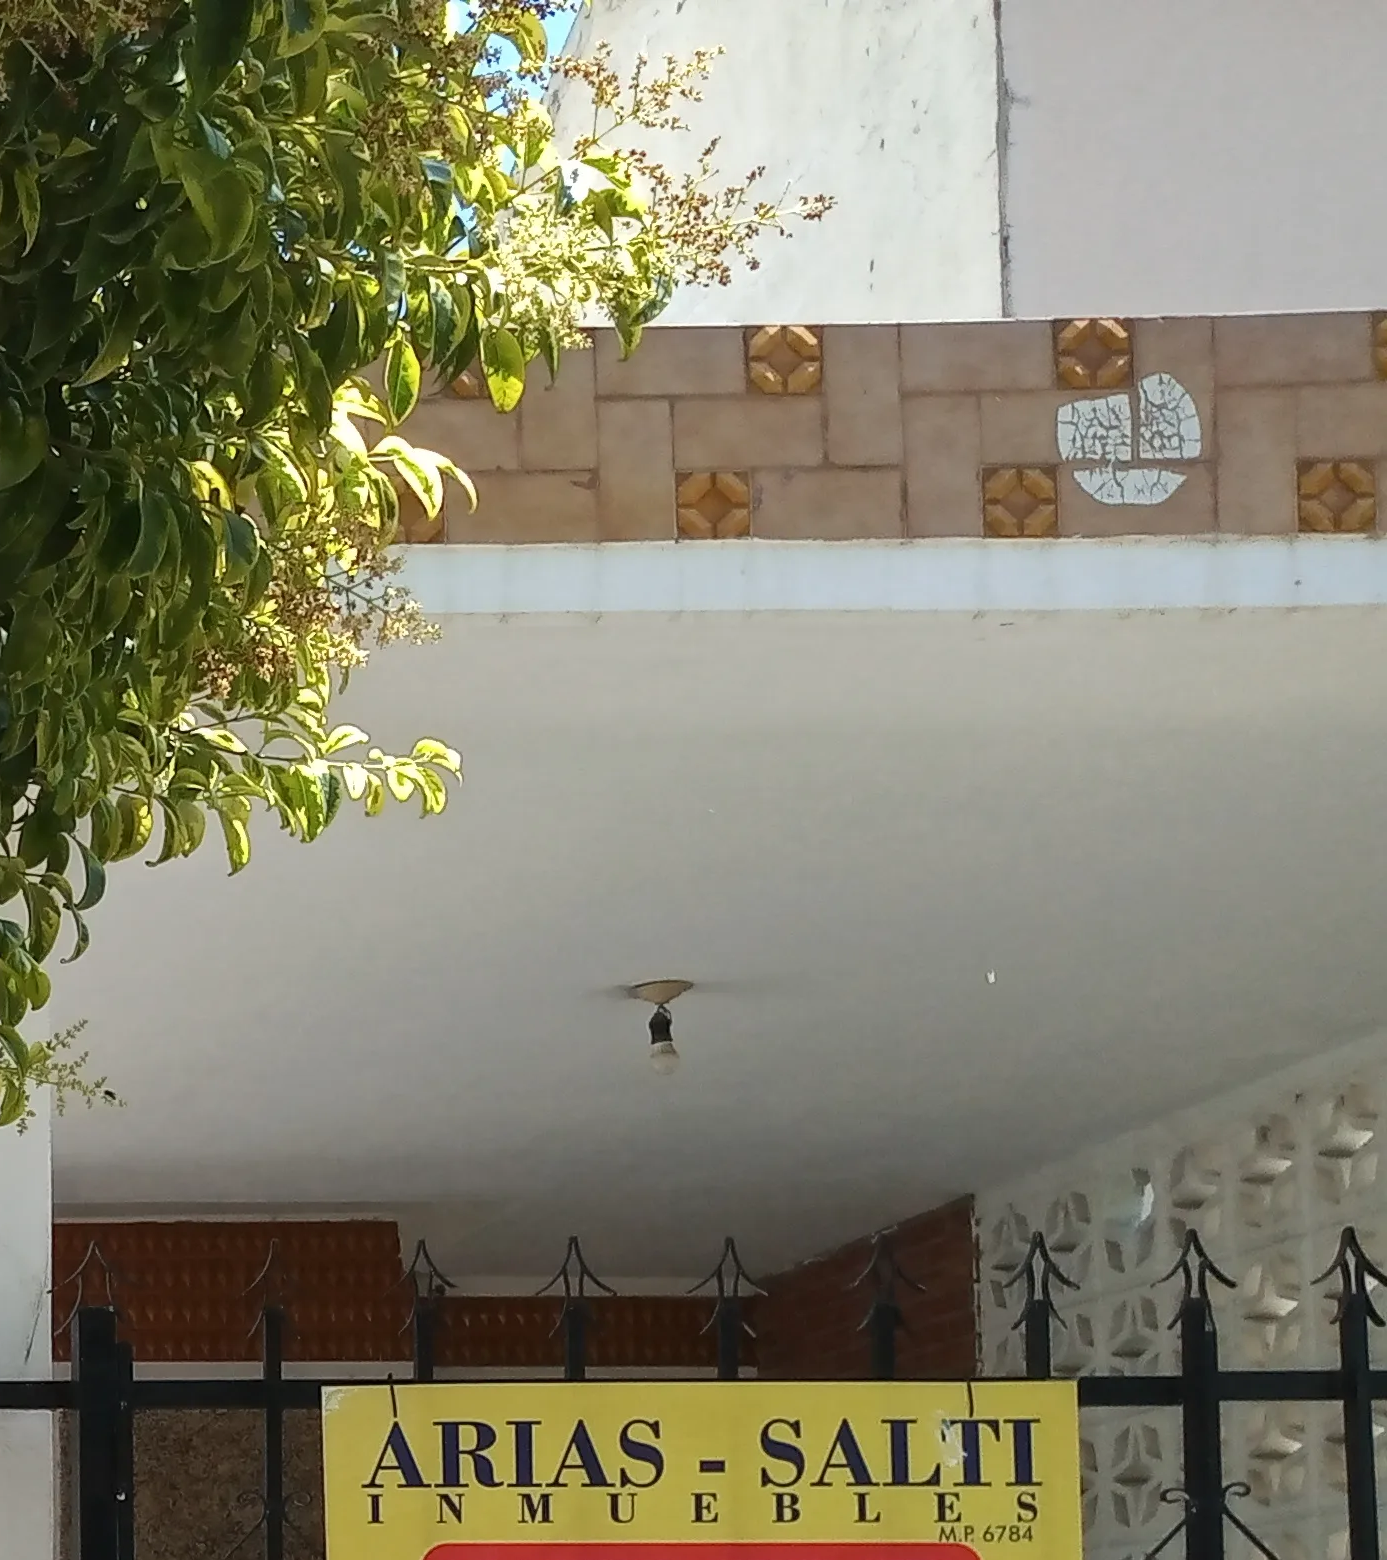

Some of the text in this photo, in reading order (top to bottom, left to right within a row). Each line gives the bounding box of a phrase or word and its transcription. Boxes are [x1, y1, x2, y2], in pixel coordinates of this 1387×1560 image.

[362, 1417, 1043, 1489] ARIAS - SALTI
[366, 1491, 1039, 1525] INMUEBLES
[982, 1525, 1034, 1543] 6784
